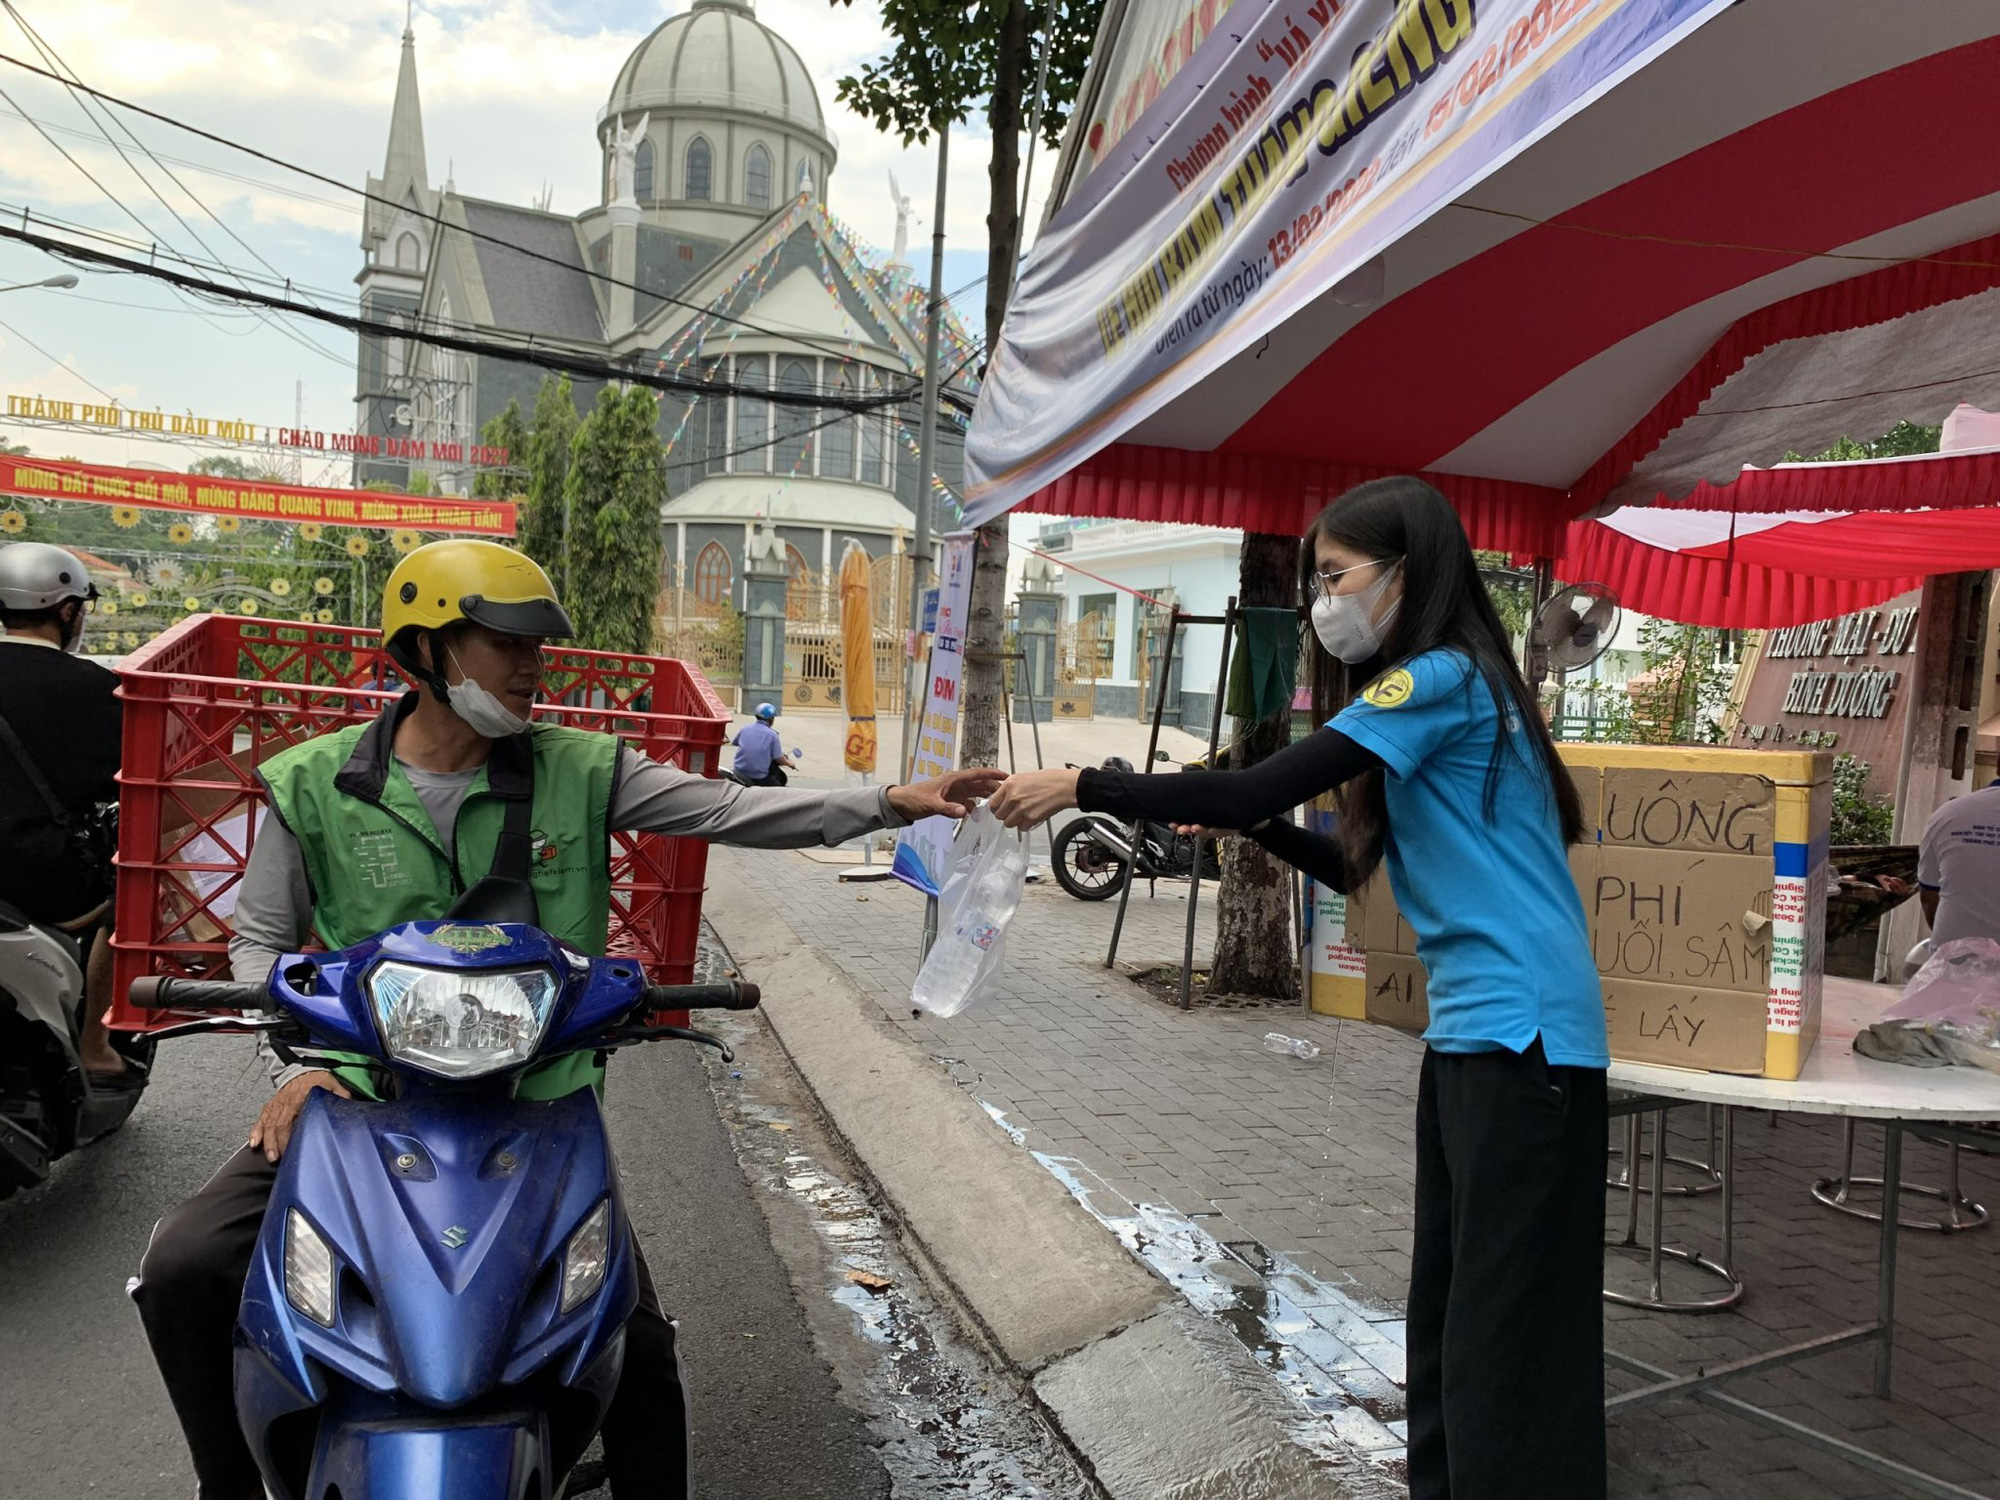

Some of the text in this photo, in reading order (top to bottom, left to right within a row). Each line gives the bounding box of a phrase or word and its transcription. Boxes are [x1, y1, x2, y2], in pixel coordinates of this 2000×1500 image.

[8, 394, 74, 421] THÀNH
[81, 398, 120, 427] PHỐ
[128, 406, 164, 432] THỦ
[216, 418, 257, 447] MỘT
[278, 425, 325, 451] CHÀO
[196, 486, 237, 510] MỪNG
[278, 496, 322, 517] QUANG
[1607, 778, 1757, 855] UỐNG
[528, 866, 588, 880] gtietkiem.vn
[1595, 858, 1706, 927] PHÍ
[1593, 918, 1767, 986] UỐI, SÂM
[1638, 995, 1706, 1048] LẤY
